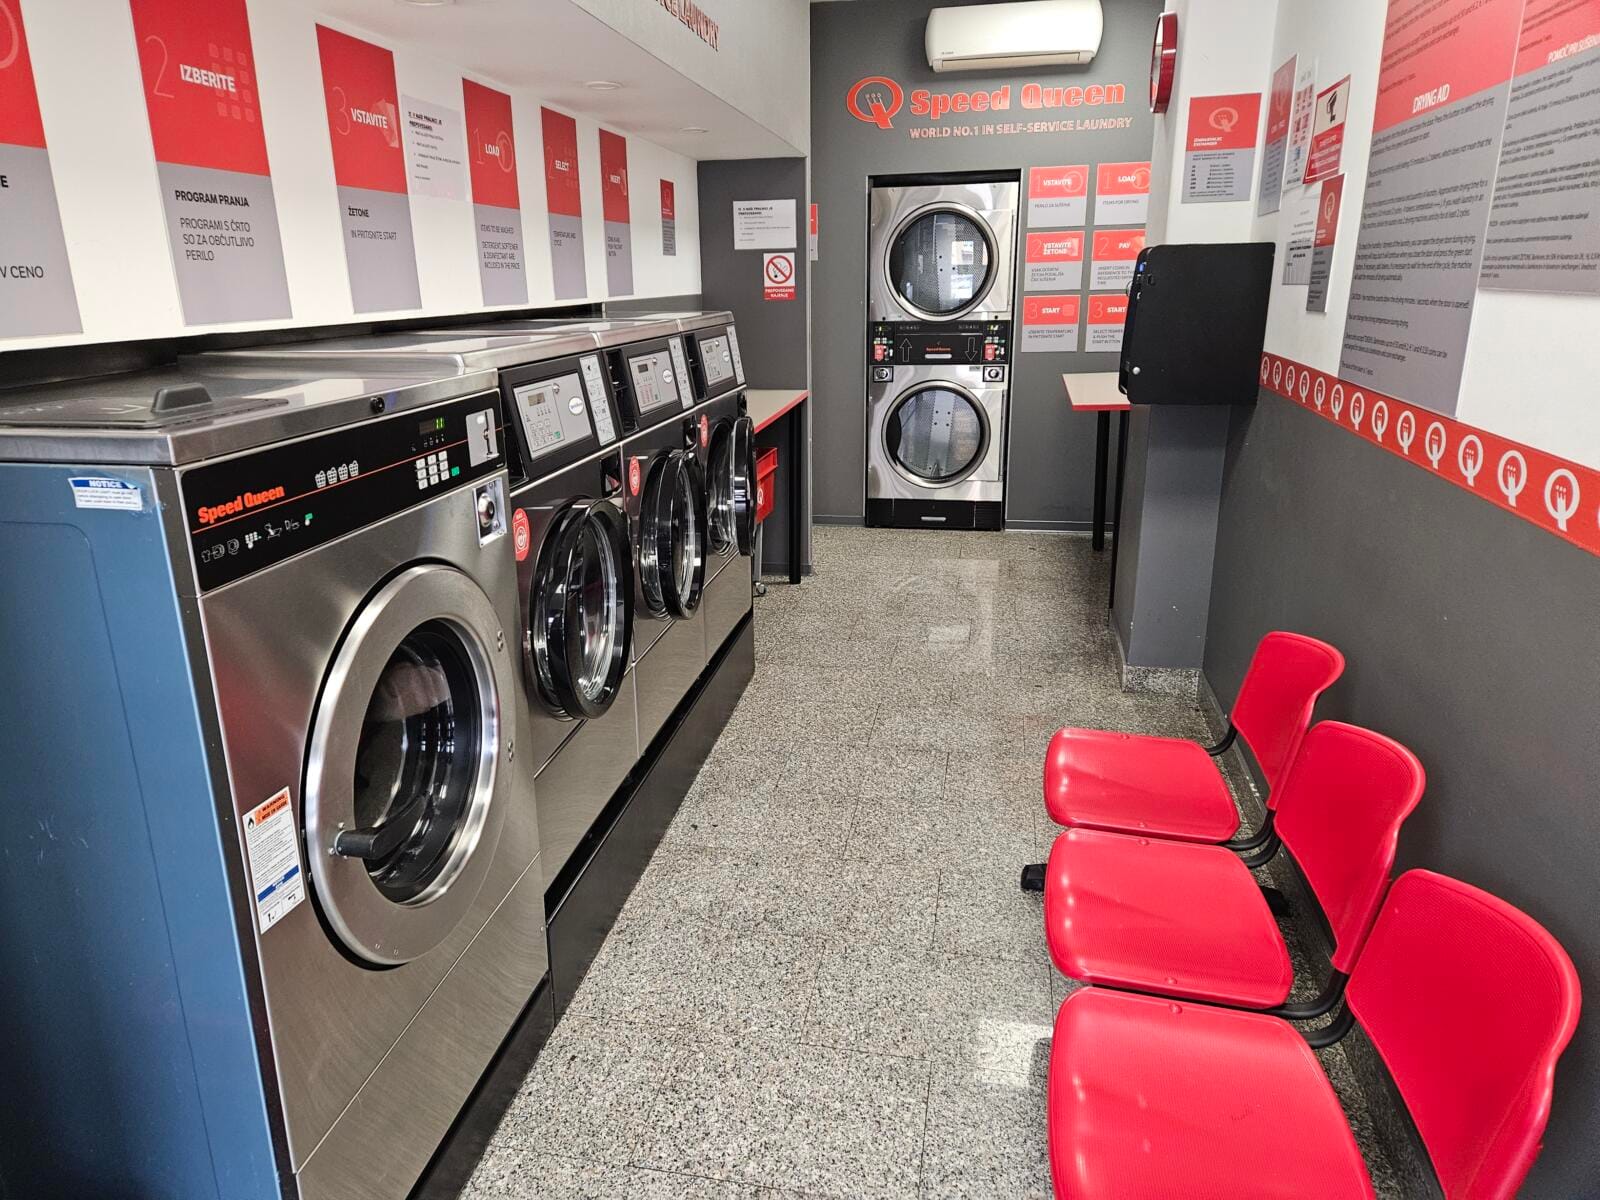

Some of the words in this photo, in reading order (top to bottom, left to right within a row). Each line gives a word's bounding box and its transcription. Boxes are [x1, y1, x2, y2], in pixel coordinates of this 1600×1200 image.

[179, 63, 237, 93] IZBERITE
[910, 85, 1011, 120] Speed
[1021, 83, 1125, 109] Queen
[1413, 90, 1437, 112] DRYING
[1436, 83, 1450, 104] AID
[350, 107, 388, 129] VSTAVITE
[910, 126, 951, 140] WORLD
[953, 124, 979, 137] NO.1
[982, 123, 994, 136] IN
[996, 119, 1074, 134] SELF-SERVICE
[1076, 116, 1133, 131] LAUNDRY
[485, 143, 500, 157] LOAD
[555, 160, 569, 172] SELECT
[1043, 178, 1073, 186] VSTAVITE
[1118, 175, 1137, 183] LOAD
[175, 189, 218, 204] PROGRAM
[219, 194, 250, 207] PRANJA
[348, 205, 370, 218] ŽETONE
[180, 217, 223, 231] PROGRAMI
[224, 220, 230, 231] S
[230, 219, 251, 232] ČRTO
[183, 233, 195, 245] SO
[196, 234, 207, 245] ZA
[208, 233, 255, 247] OBČUTLJIVO
[351, 229, 357, 238] IN
[383, 231, 397, 240] START
[1043, 241, 1072, 250] VSTAVITE
[1118, 241, 1131, 249] PAY
[186, 249, 215, 261] PERILO
[10, 265, 44, 279] CENO
[89, 479, 123, 488] NOTICE
[198, 495, 244, 524] Speed
[243, 485, 286, 509] Queen
